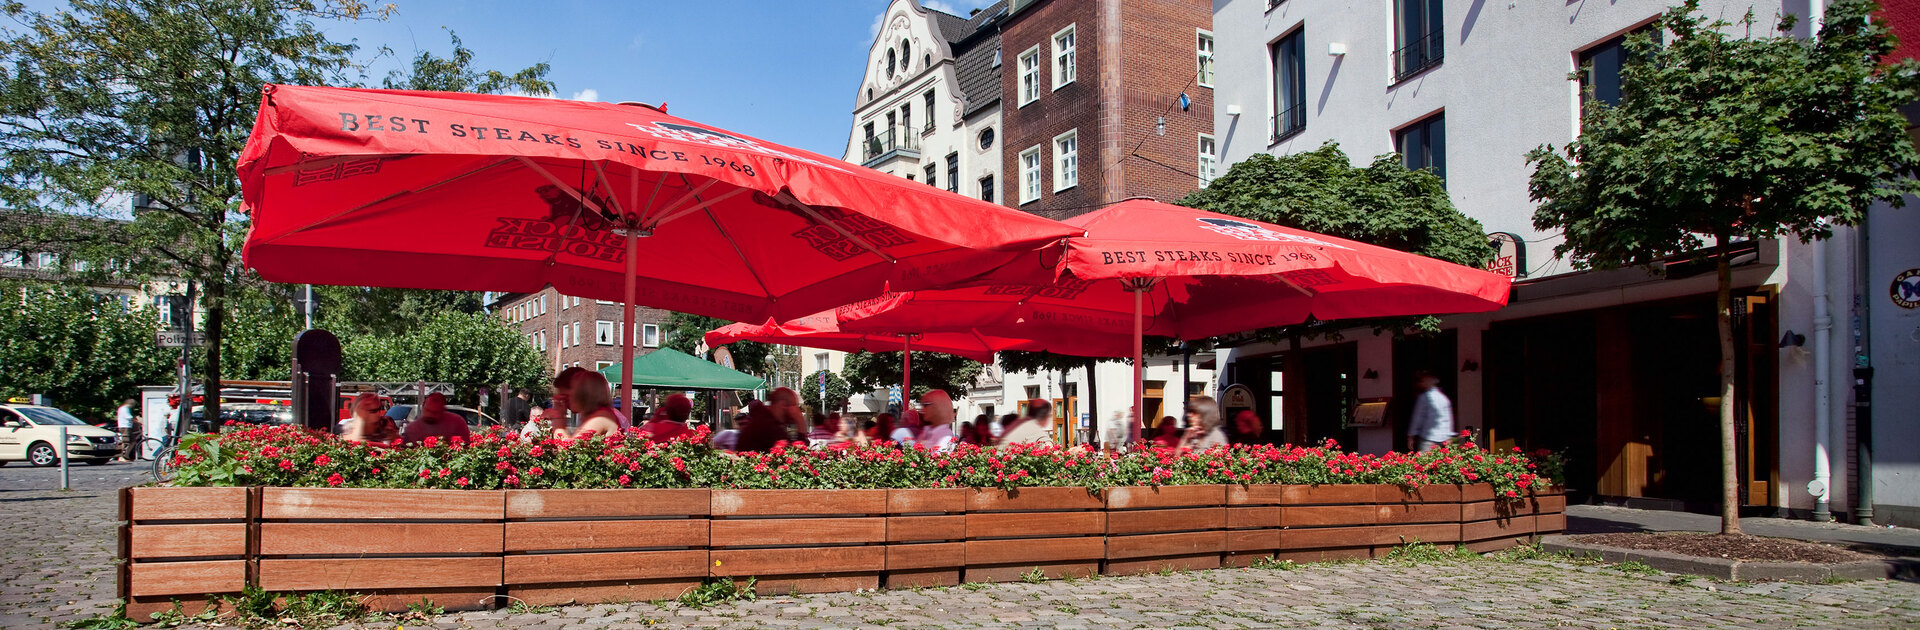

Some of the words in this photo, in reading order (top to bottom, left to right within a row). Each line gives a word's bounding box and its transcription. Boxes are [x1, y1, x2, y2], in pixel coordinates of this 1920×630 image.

[338, 111, 430, 133] BEST
[450, 123, 581, 148] STEAKS
[597, 139, 688, 162] SINCE
[701, 154, 756, 177] 1968
[1101, 251, 1147, 265] BEST
[1155, 250, 1222, 262] STEAKS
[1227, 251, 1276, 266] SINCE
[1280, 252, 1317, 263] 1968
[158, 333, 197, 344] Polizi
